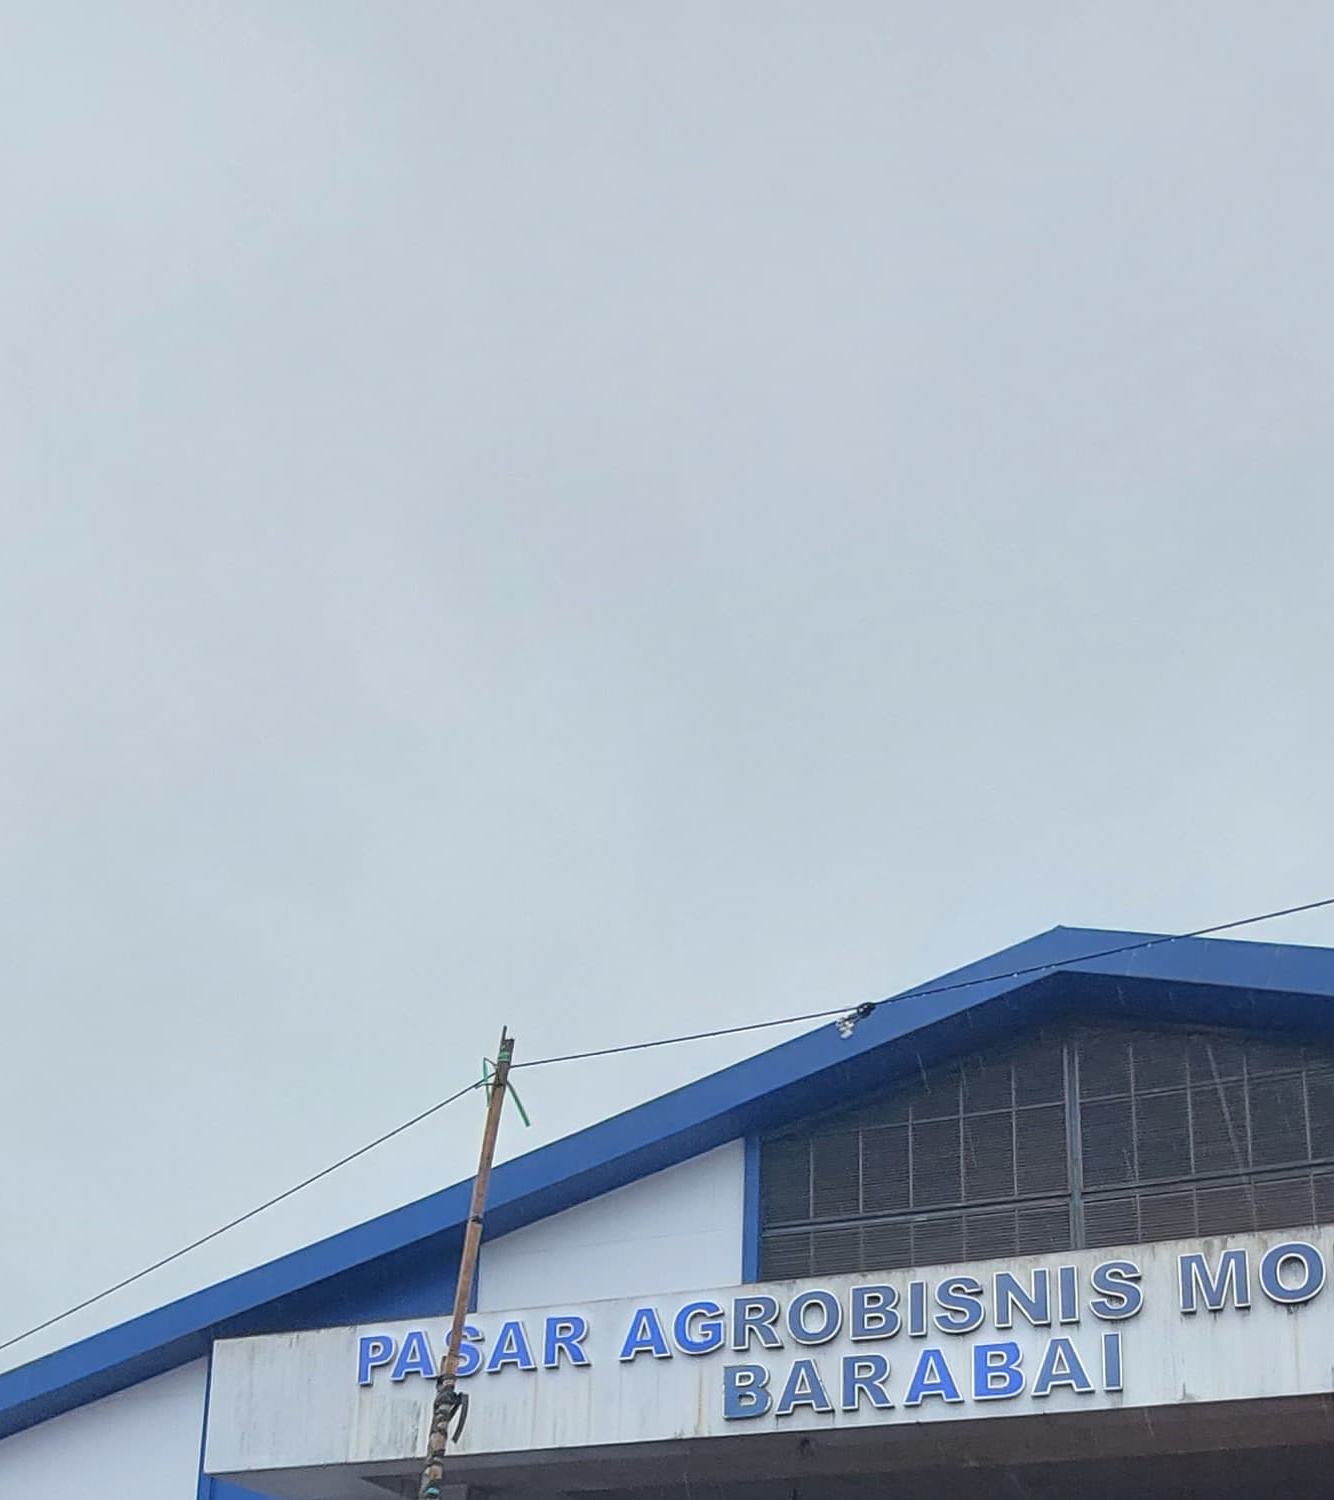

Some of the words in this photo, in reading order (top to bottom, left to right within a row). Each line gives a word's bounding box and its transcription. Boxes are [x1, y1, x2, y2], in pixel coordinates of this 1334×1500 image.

[357, 1312, 592, 1387] PASAR
[619, 1259, 1144, 1362] AGROBISNIS
[722, 1331, 1124, 1421] BARABAI
